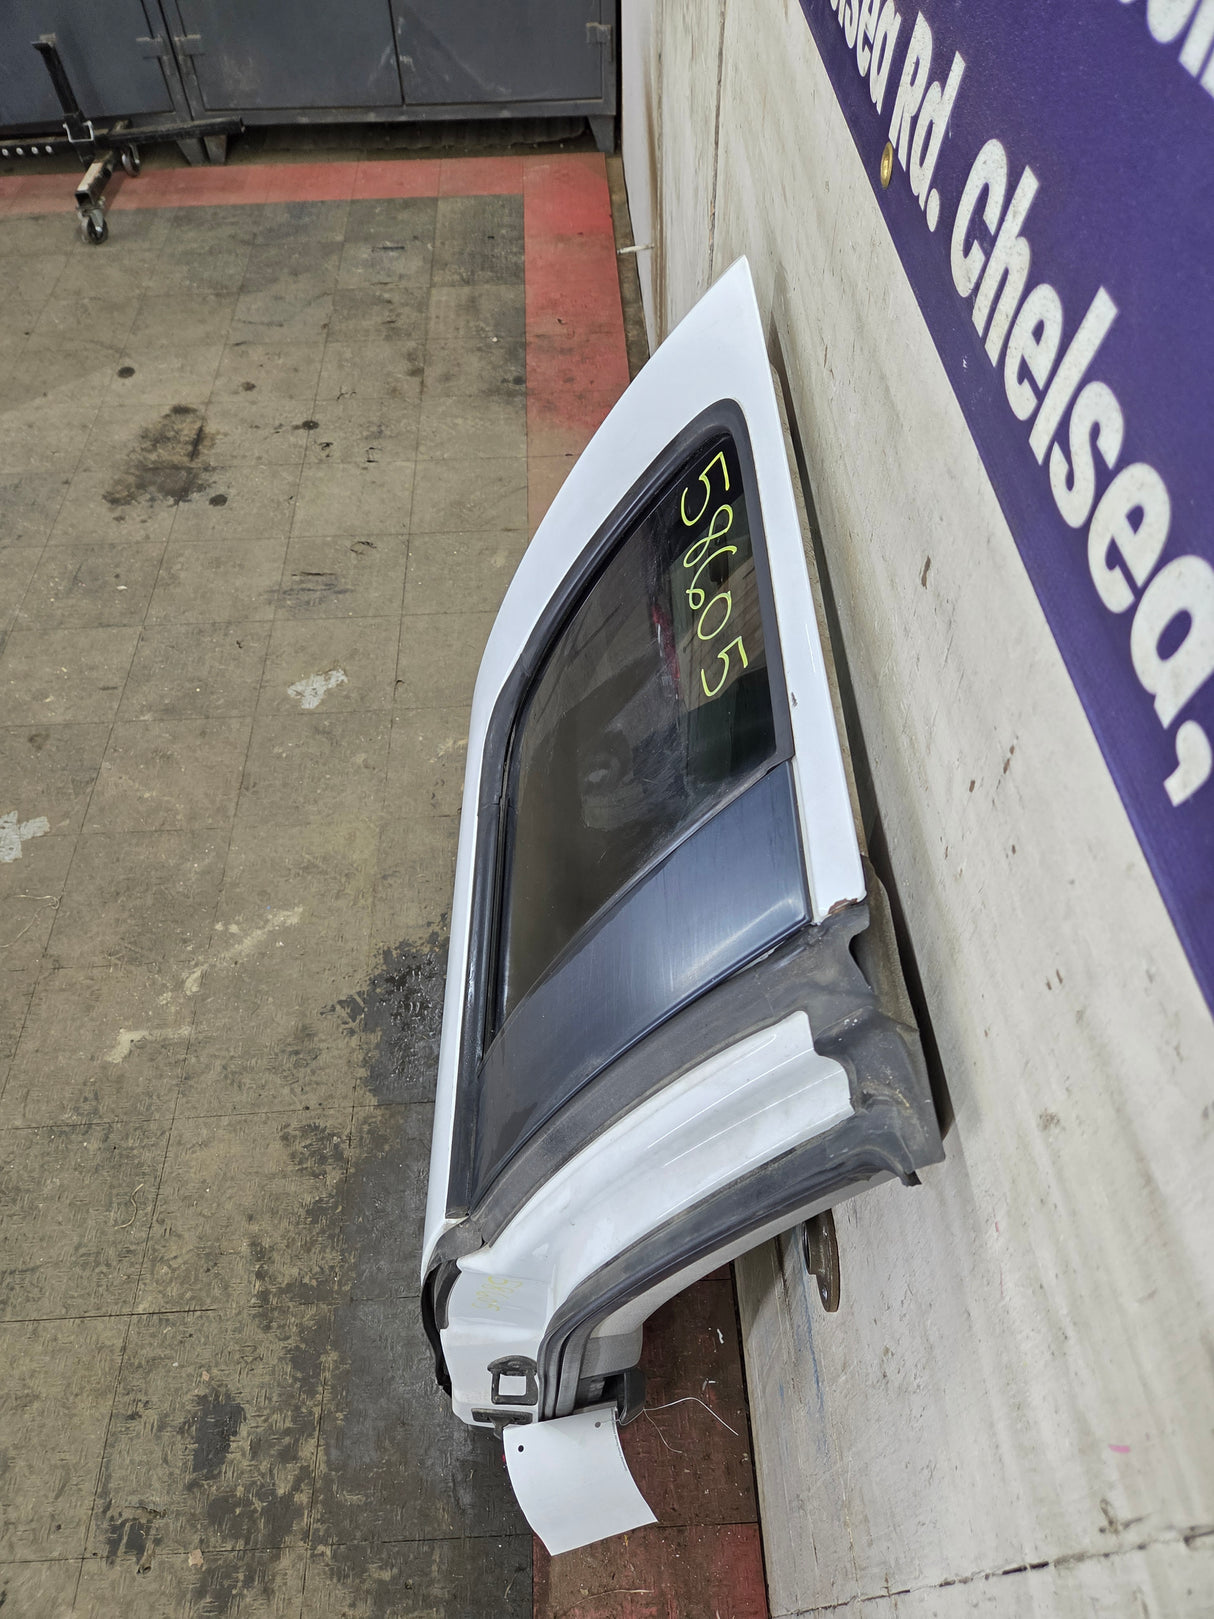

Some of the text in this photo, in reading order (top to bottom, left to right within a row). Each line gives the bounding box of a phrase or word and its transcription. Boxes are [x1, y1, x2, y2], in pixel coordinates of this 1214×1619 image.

[680, 451, 749, 697] 58605
[889, 10, 966, 232] Rd.
[950, 138, 1214, 808] Chelsea,
